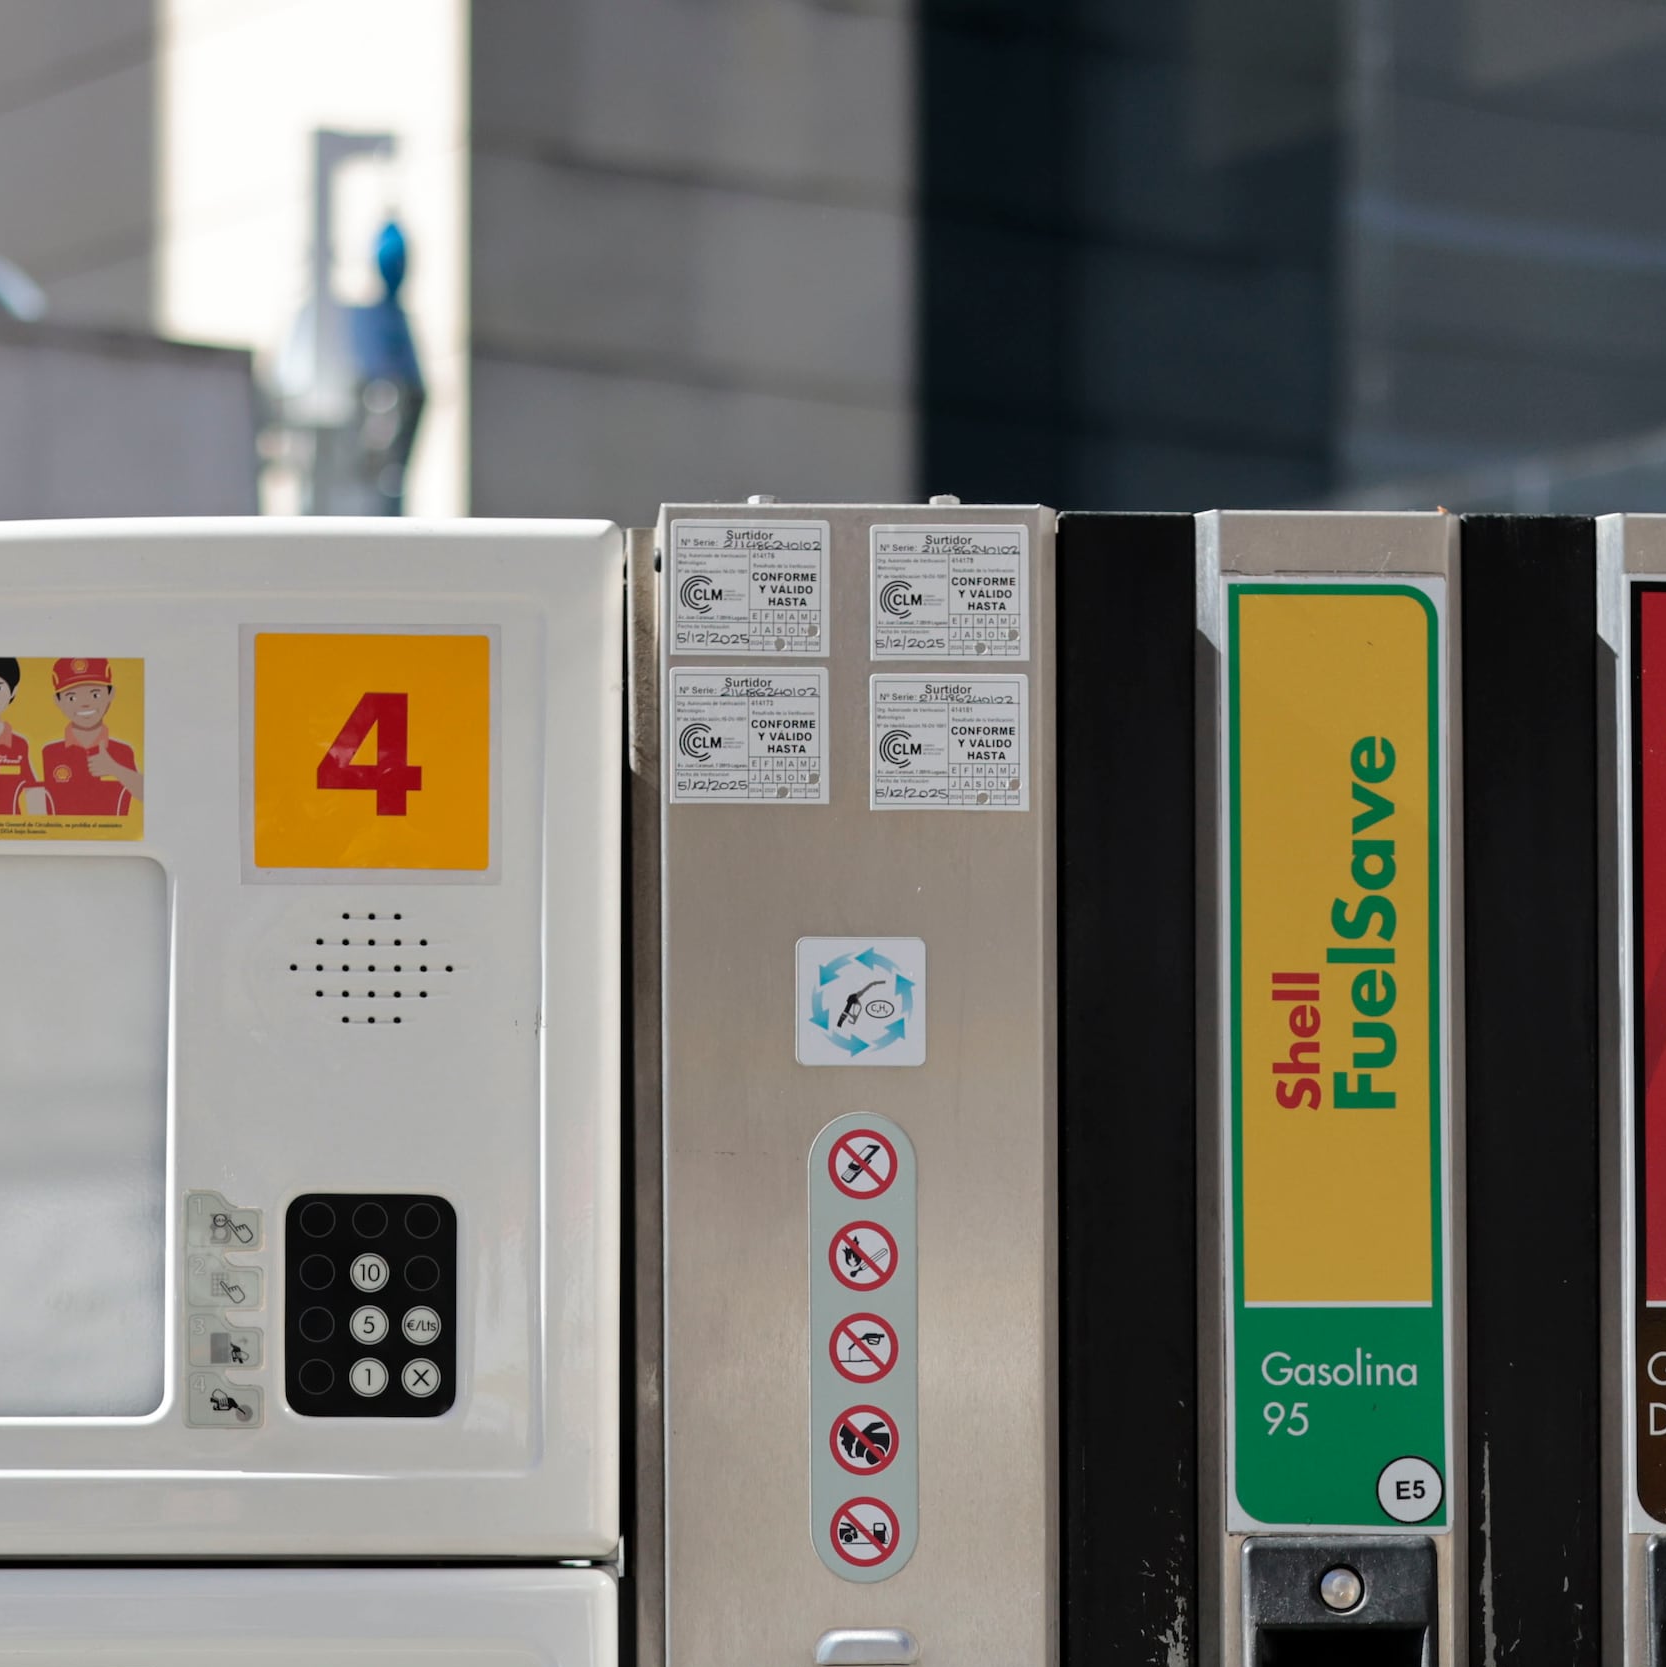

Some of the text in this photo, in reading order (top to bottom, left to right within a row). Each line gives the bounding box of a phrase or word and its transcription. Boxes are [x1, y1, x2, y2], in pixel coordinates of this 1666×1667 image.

[726, 529, 774, 541] Surtidor
[925, 534, 973, 545] Surtidor
[693, 538, 719, 547] Serie:
[752, 572, 817, 582] CONFORME
[951, 577, 1016, 586] CONFORME
[759, 583, 814, 594] Y VÁLIDO
[958, 588, 1012, 599] Y VÁLIDO
[693, 588, 723, 601] CLM
[893, 594, 922, 606] CLM
[768, 597, 807, 607] HASTA
[967, 602, 1006, 611] HASTA
[724, 677, 772, 688] Surtidor
[924, 684, 972, 695] Surtidor
[751, 719, 816, 729] CONFORME
[758, 731, 813, 742] Y VÁLIDO
[951, 726, 1016, 736] CONFORME
[692, 736, 722, 749] CLM
[958, 737, 1012, 748] Y VÁLIDO
[317, 692, 422, 816] 4
[767, 744, 807, 754] HASTA
[892, 743, 922, 755] CLM
[967, 751, 1006, 760] HASTA
[1326, 735, 1397, 1110] FuelSave
[1272, 972, 1322, 1111] Shell
[359, 1263, 381, 1282] 10
[363, 1316, 375, 1334] 5
[1261, 1347, 1418, 1387] Gasolina
[364, 1368, 372, 1386] 1
[1263, 1400, 1310, 1437] 95
[1395, 1479, 1426, 1500] E5
